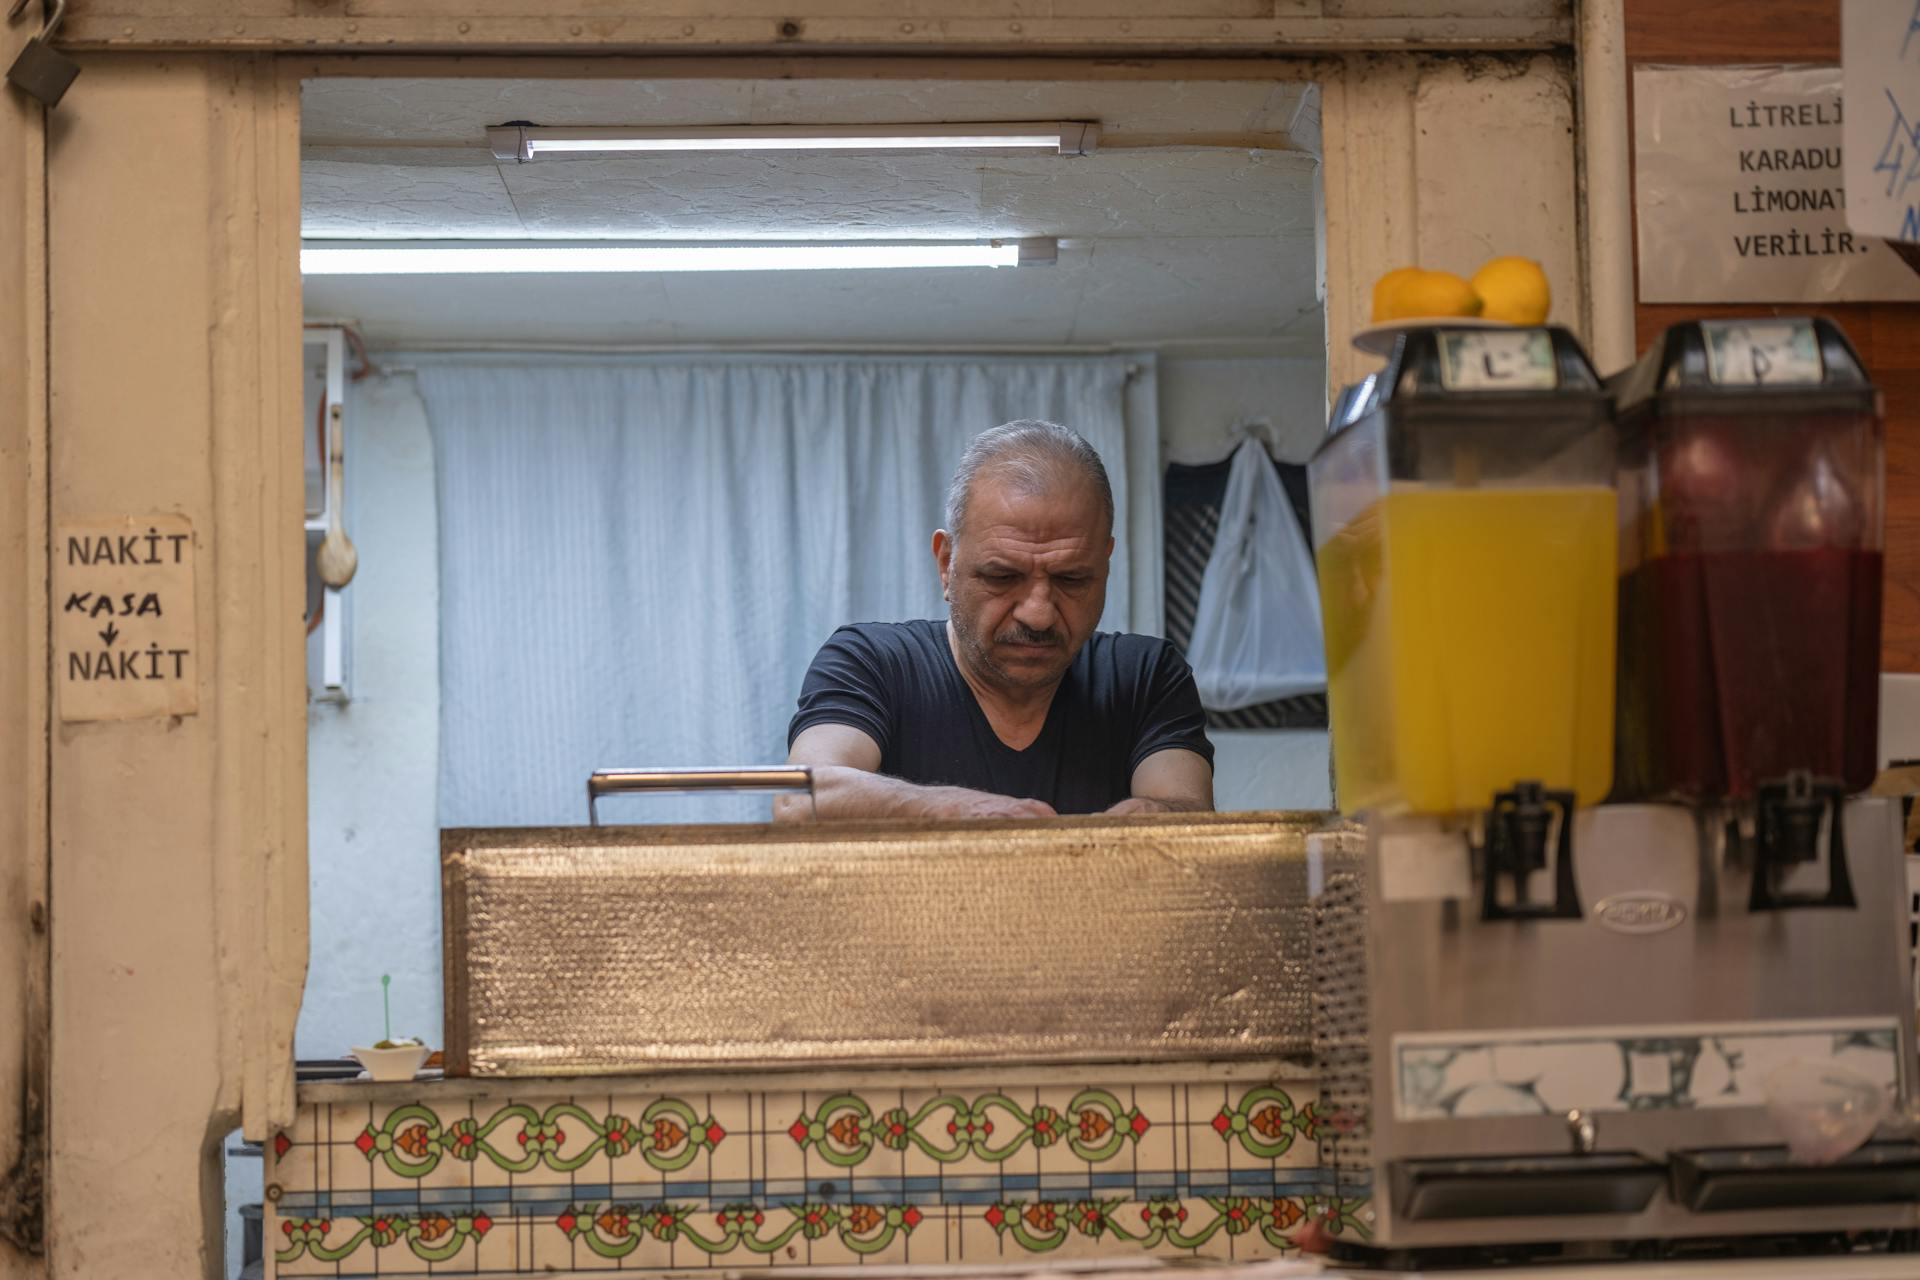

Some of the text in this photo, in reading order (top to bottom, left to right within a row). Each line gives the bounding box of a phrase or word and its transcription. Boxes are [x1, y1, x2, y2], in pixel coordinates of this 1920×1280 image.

[1740, 148, 1842, 172] KARADU
[1734, 228, 1869, 257] VERİLİR.
[68, 528, 188, 566] NAKİT
[64, 592, 163, 618] KASA
[69, 642, 189, 681] NAKİT
